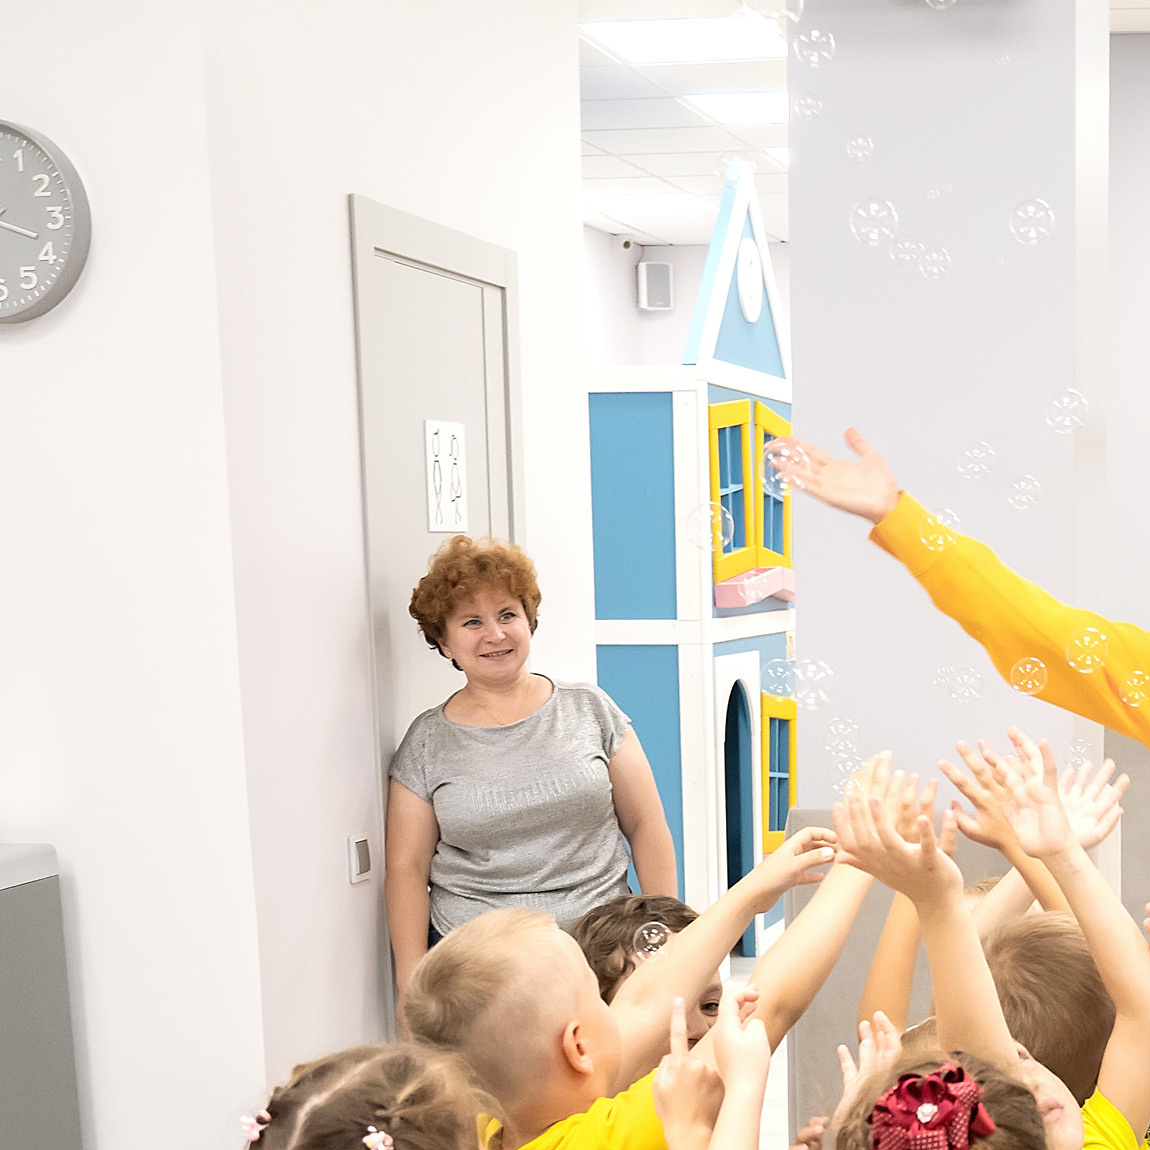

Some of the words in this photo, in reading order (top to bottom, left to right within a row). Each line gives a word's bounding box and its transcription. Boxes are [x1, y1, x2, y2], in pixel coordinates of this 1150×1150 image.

[13, 150, 24, 172] 1
[32, 174, 51, 197] 2
[46, 206, 65, 230] 3
[38, 241, 57, 264] 4
[20, 266, 38, 290] 5
